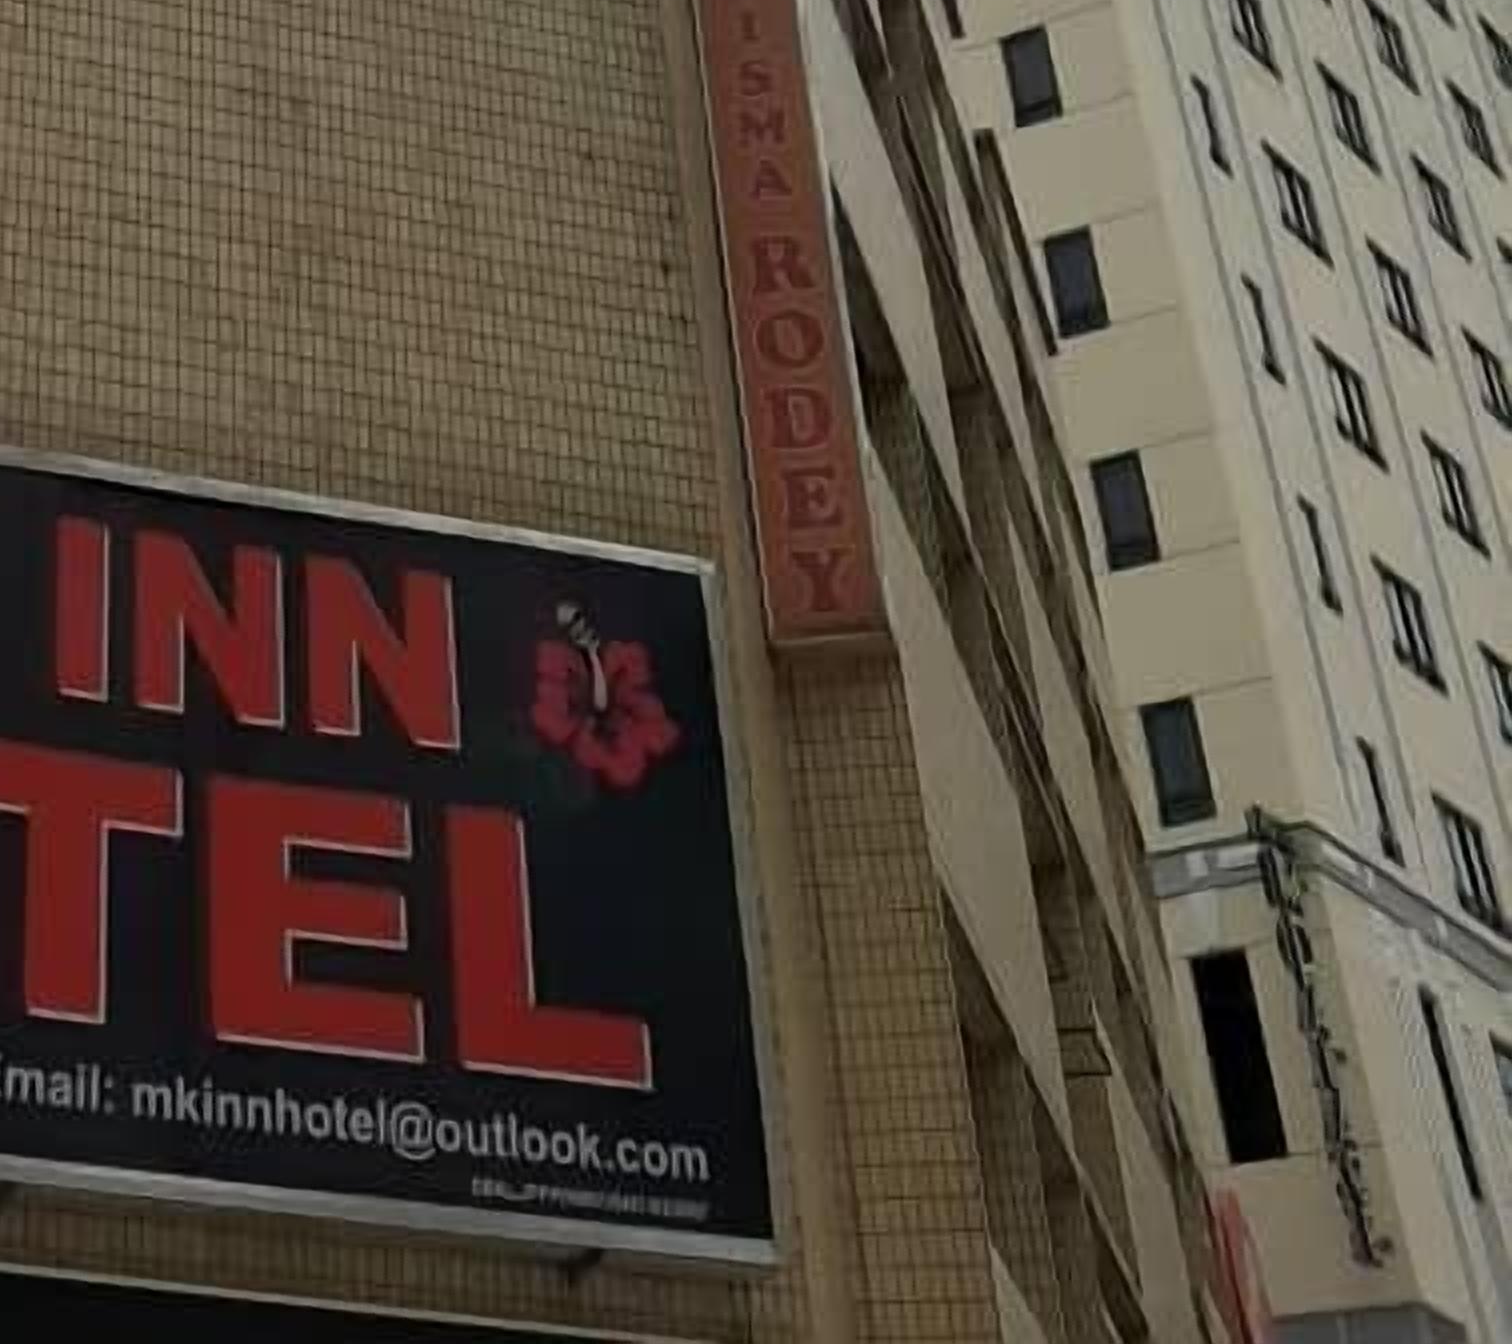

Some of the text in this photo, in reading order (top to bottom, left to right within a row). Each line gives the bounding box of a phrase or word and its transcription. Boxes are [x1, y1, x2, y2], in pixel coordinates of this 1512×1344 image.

[751, 235, 846, 612] RODEY
[51, 515, 464, 751] INN
[131, 1075, 710, 1182] mkinnhotel@outlook.com
